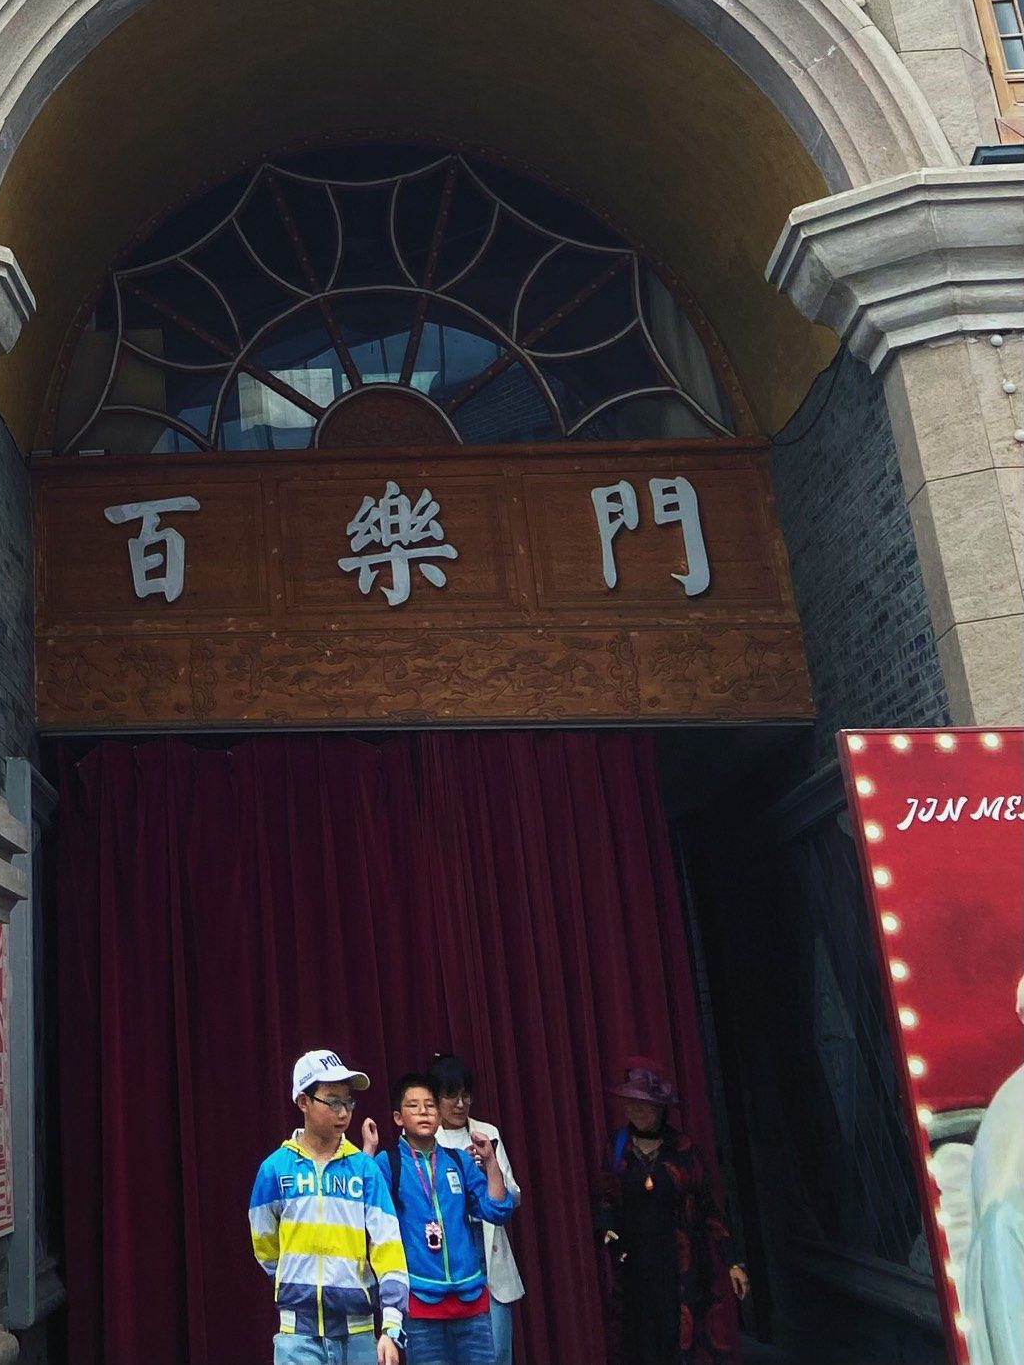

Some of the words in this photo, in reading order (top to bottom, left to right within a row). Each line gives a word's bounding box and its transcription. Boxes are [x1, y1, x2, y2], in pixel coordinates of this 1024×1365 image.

[104, 475, 711, 606] 百樂門
[969, 795, 1024, 821] ME
